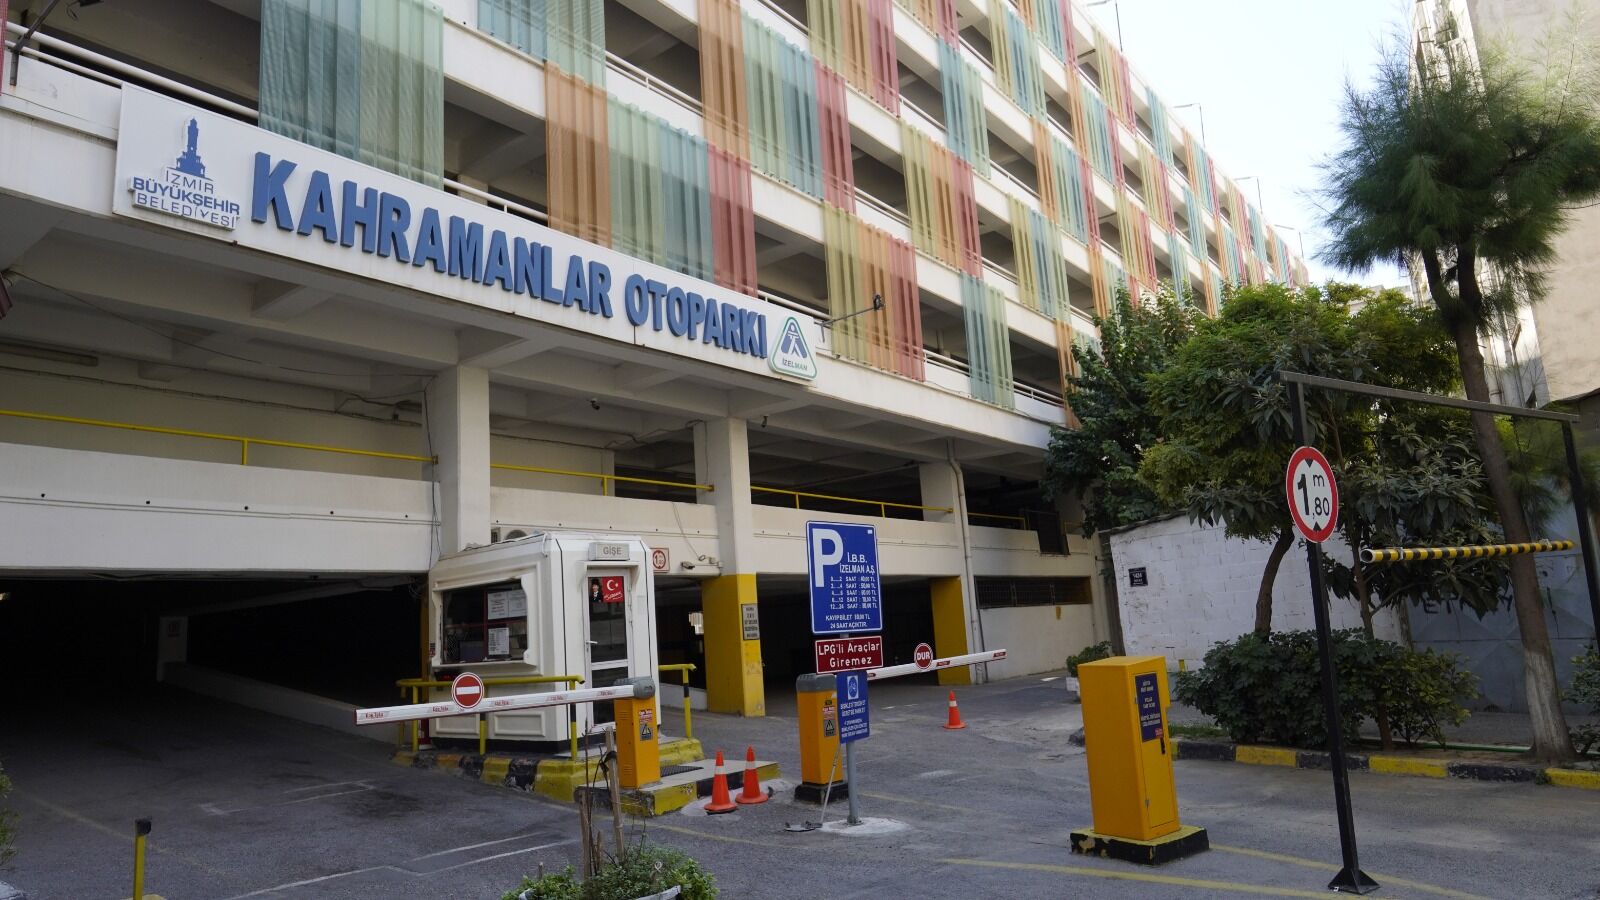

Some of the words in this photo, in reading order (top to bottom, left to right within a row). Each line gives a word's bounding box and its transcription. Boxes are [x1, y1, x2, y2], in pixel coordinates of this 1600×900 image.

[133, 176, 240, 216] BÜYÜKŞEHİR
[137, 192, 235, 228] BELEDİYESİ
[251, 151, 613, 318] KAHRAMANLAR
[624, 273, 767, 359] OTOPARKI
[603, 545, 622, 556] GİŞE
[812, 528, 844, 588] P
[847, 641, 879, 653] Araçlar
[916, 651, 930, 660] DUR
[829, 656, 872, 668] Giremez
